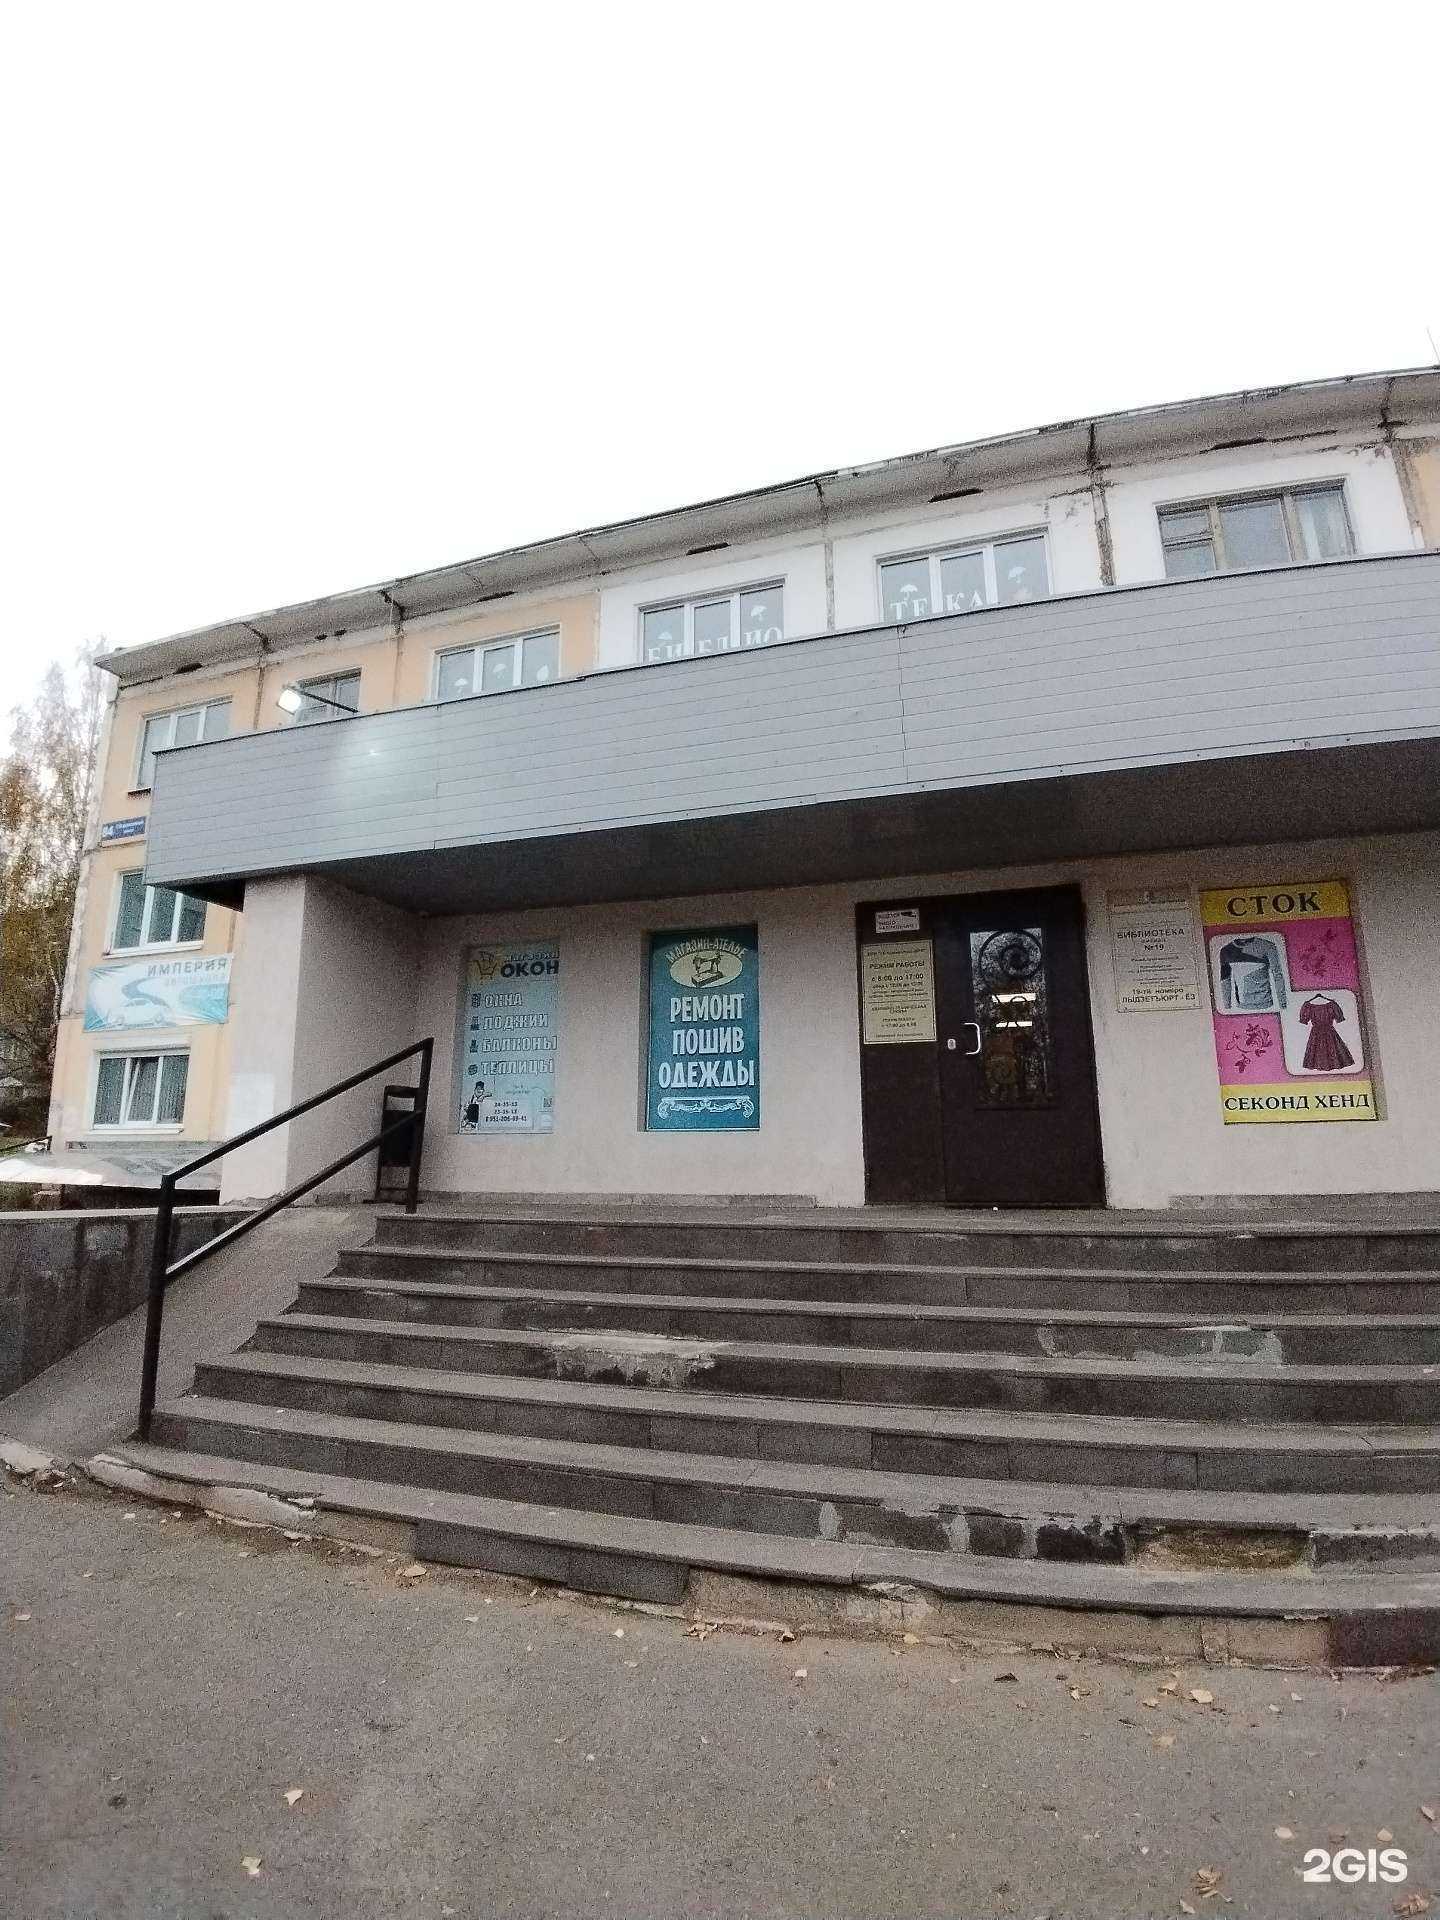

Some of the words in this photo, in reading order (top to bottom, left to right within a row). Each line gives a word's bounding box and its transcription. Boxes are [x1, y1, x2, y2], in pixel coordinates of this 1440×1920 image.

[1227, 891, 1321, 917] СТОК
[1117, 928, 1186, 939] БИБЛИОТЕКА
[147, 958, 228, 977] ИМПЕРИЯ
[500, 960, 560, 978] ОКОН
[895, 960, 925, 968] РАБОТЫ
[484, 992, 523, 1009] ОКНА
[669, 993, 745, 1023] РЕМОНТ
[483, 1013, 549, 1031] ЛОДЖИИ
[482, 1035, 558, 1053] БАЛКОНЫ
[672, 1026, 745, 1055] ПОШИВ
[481, 1058, 554, 1076] ТЕПЛИЦЫ
[658, 1059, 756, 1089] ОДЕЖДЫ
[1224, 1096, 1310, 1111] СЕКОНД
[1315, 1093, 1370, 1109] ХЕНД
